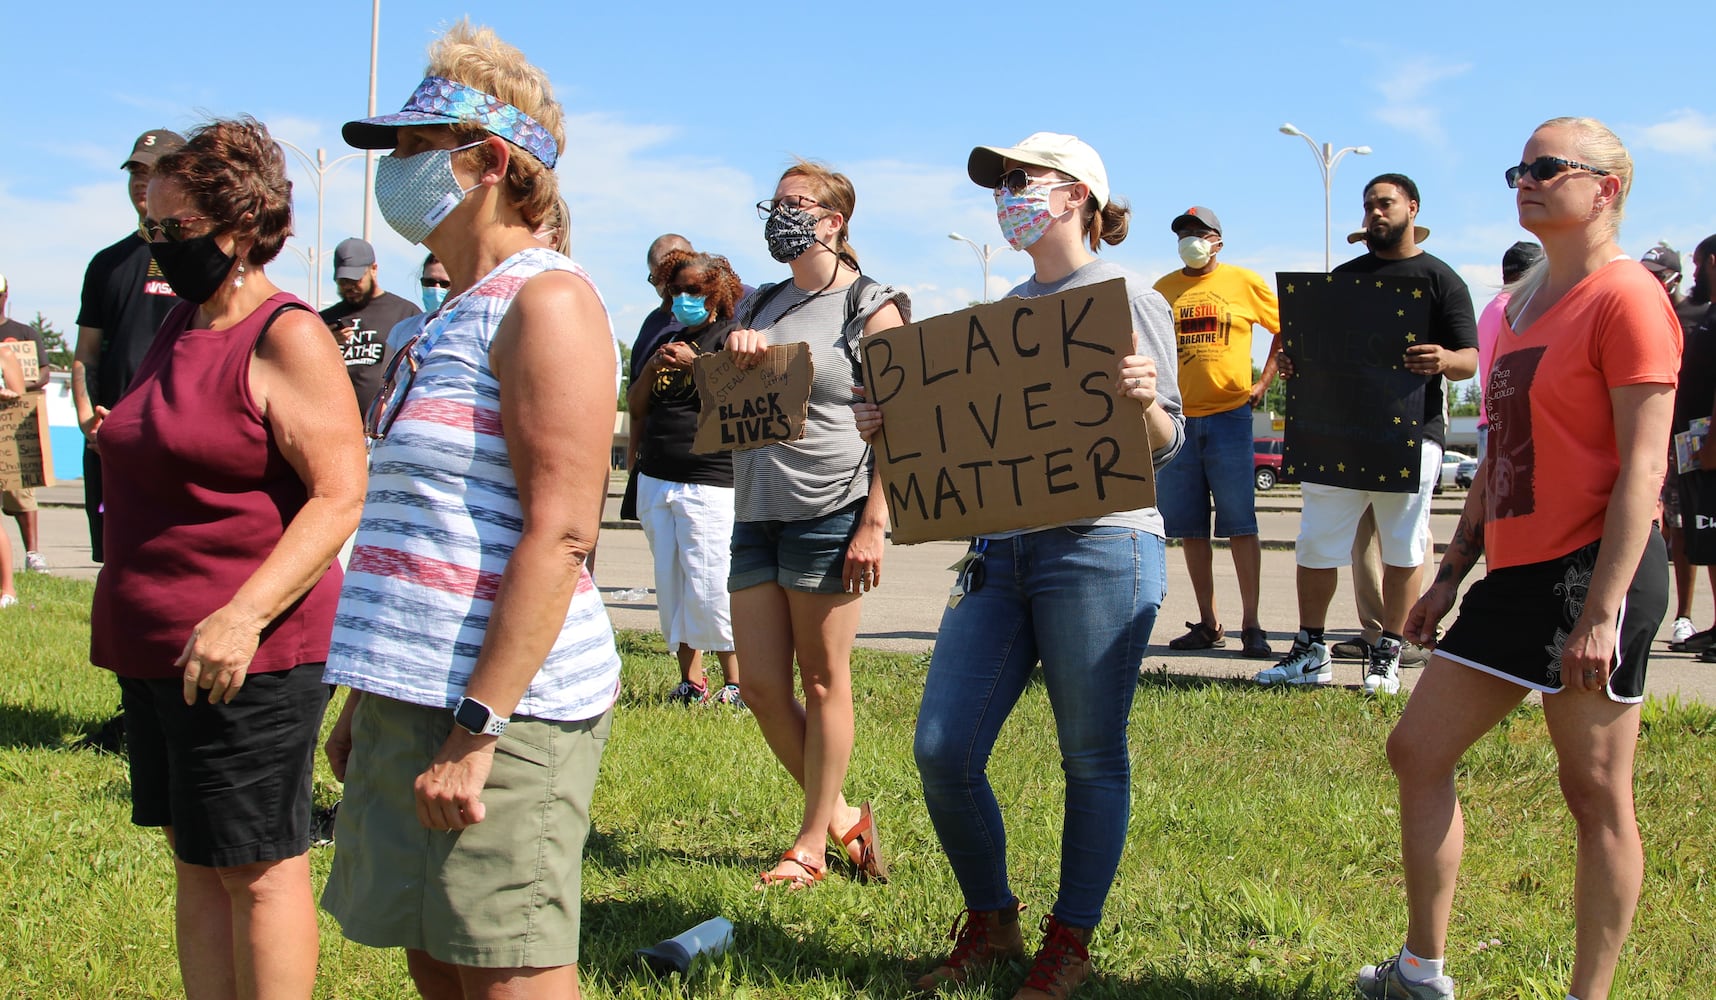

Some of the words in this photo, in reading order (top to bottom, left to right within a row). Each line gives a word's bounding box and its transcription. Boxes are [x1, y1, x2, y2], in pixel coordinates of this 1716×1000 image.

[144, 135, 156, 146] 3
[351, 318, 362, 330] I
[1180, 307, 1194, 318] WE
[1195, 304, 1217, 317] STILL
[864, 297, 1115, 406] BLACK
[1180, 333, 1216, 345] BREATHE
[719, 392, 783, 421] BLACK
[881, 371, 1114, 465] LIVES
[721, 414, 791, 444] LIVES
[889, 437, 1146, 528] MATTER
